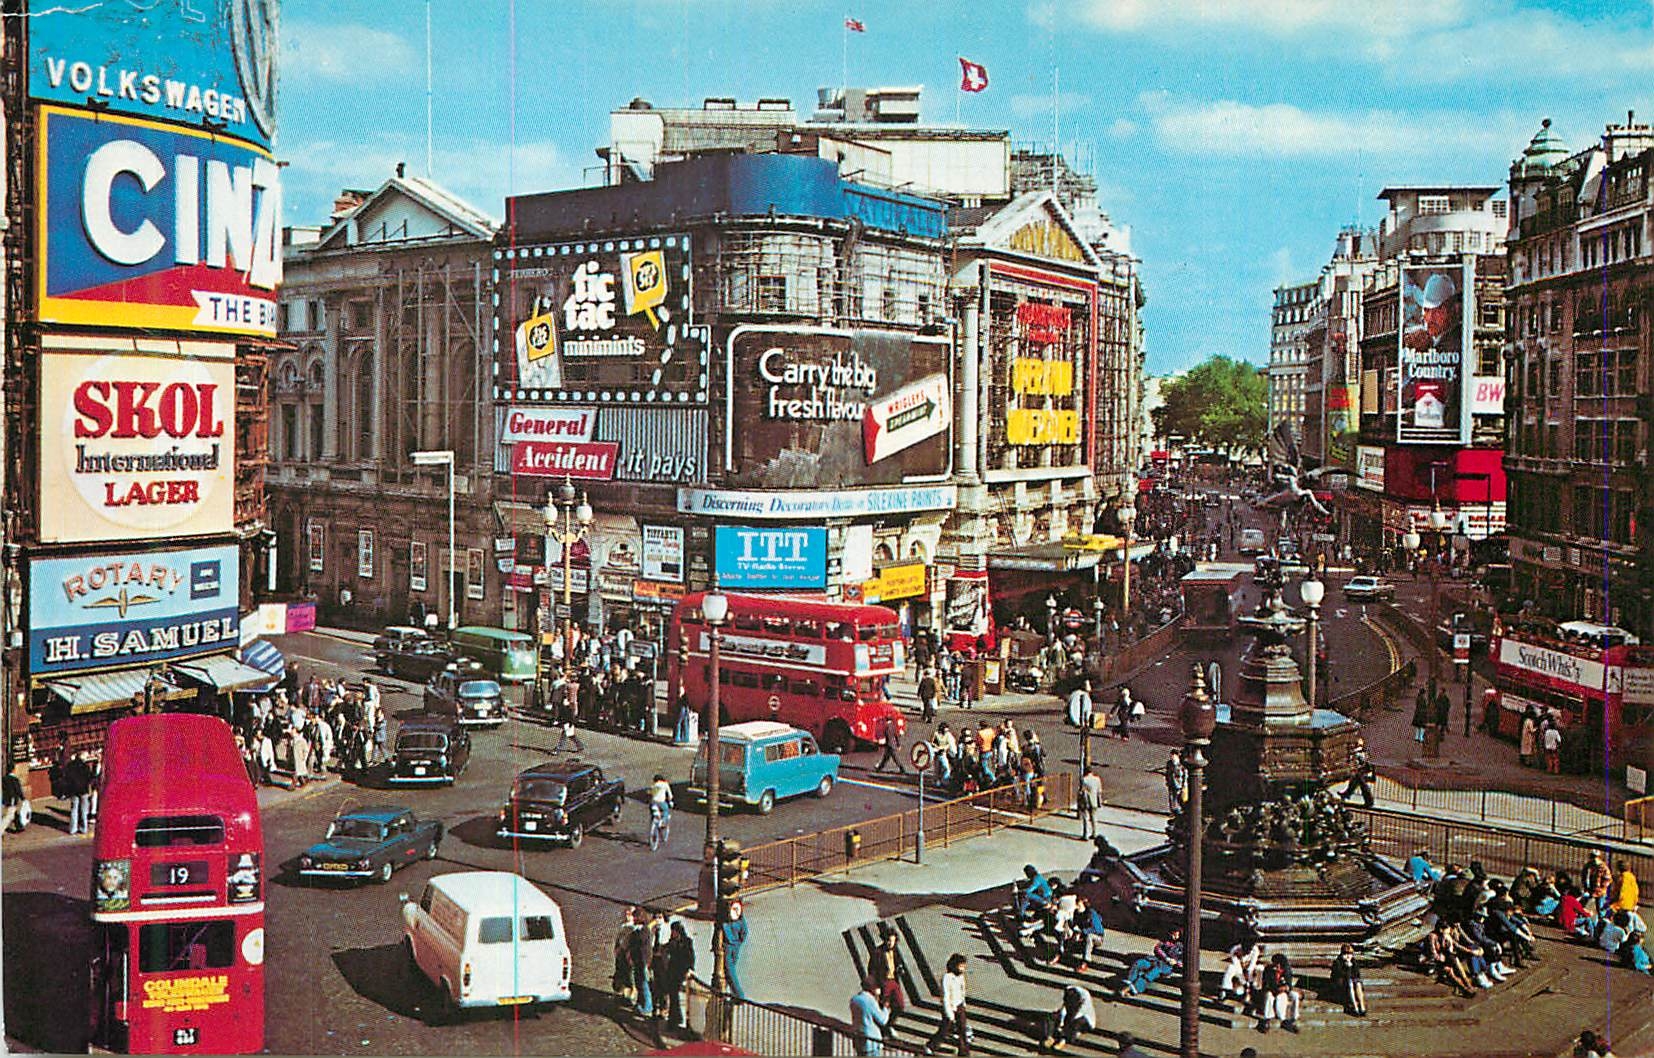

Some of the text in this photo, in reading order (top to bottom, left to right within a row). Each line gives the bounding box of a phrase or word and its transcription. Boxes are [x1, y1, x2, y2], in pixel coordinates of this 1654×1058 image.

[46, 56, 248, 124] VOLKSWAGEN
[572, 260, 616, 303] tic
[209, 296, 251, 323] THE
[563, 294, 616, 331] tac
[563, 334, 646, 357] minimints
[1403, 347, 1460, 364] Marlboro
[759, 349, 877, 395] Carry the big
[73, 380, 225, 439] SKOL
[769, 385, 825, 419] fresh
[825, 386, 867, 419] flavour
[509, 412, 588, 437] General
[75, 443, 220, 474] International
[518, 446, 609, 471] Accident
[627, 448, 696, 480] it pays
[103, 480, 201, 508] LAGER
[702, 494, 764, 514] Discerning
[737, 531, 808, 562] ITT
[63, 561, 186, 603] ROTARY
[46, 616, 240, 663] H. SAMUEL
[1519, 645, 1547, 672] Scotch
[169, 867, 189, 884] 19
[143, 975, 229, 993] COLINDALE
